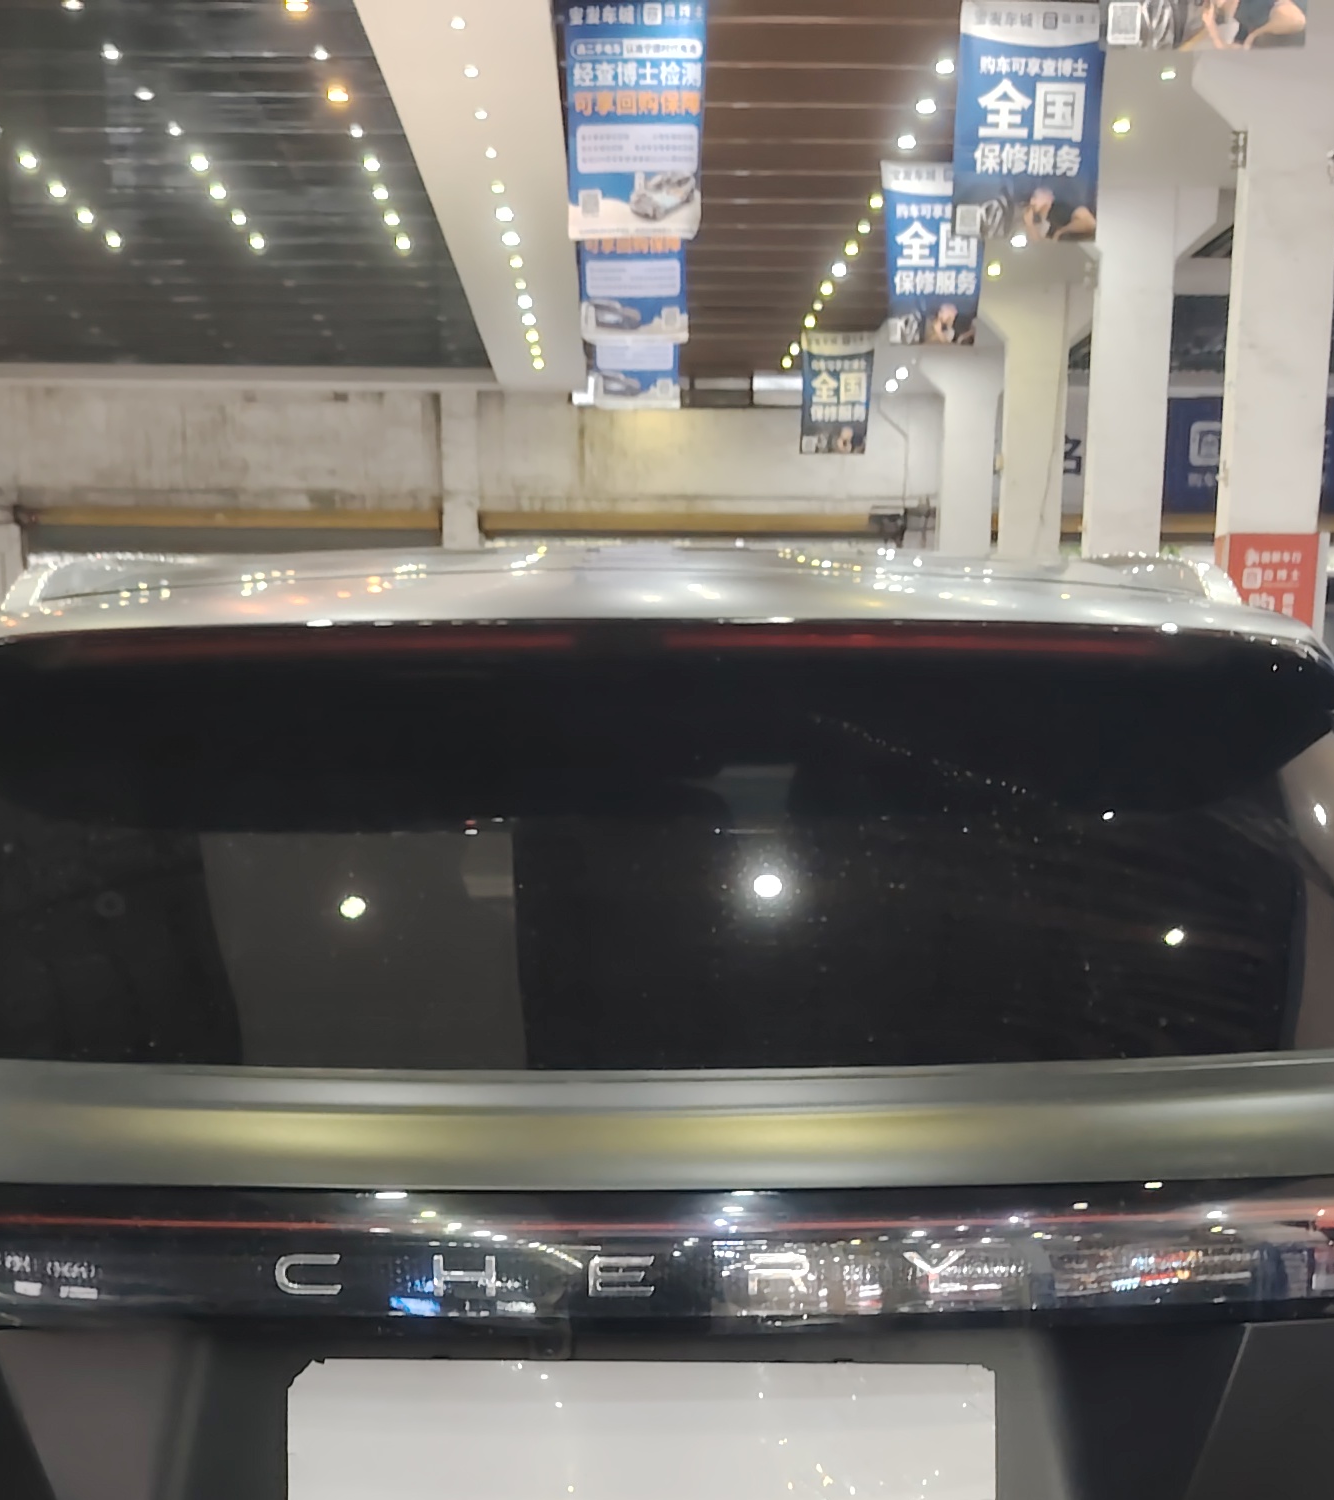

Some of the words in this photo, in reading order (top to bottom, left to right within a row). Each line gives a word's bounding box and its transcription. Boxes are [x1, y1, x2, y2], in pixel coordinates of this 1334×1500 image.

[573, 61, 702, 87] 经查博士检测
[980, 56, 1088, 77] 购车可享查博士
[574, 90, 701, 117] 可享回购保障
[978, 78, 1086, 142] 全国
[974, 143, 1081, 176] 保修服务
[895, 221, 978, 268] 全国
[894, 270, 977, 296] 保修服务
[811, 371, 867, 403] 全国
[274, 1250, 966, 1297] CHERY
